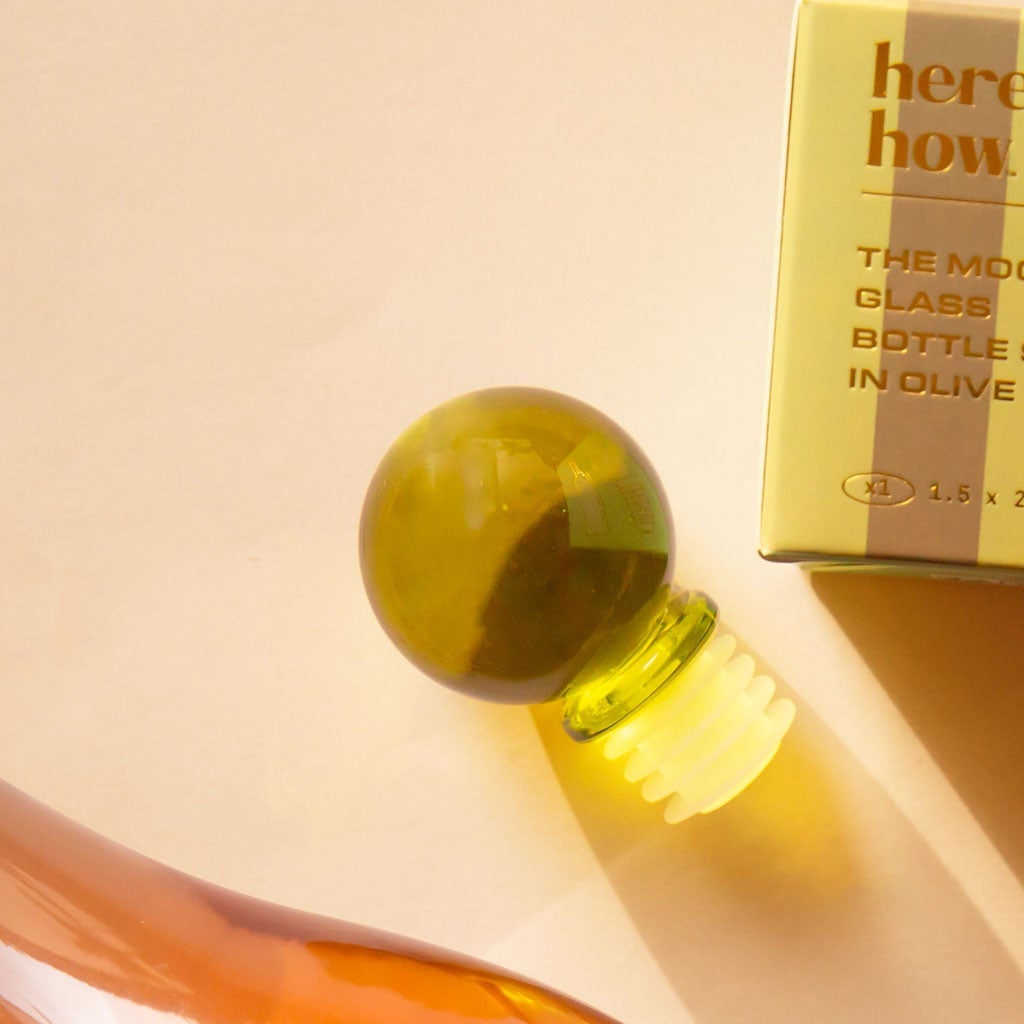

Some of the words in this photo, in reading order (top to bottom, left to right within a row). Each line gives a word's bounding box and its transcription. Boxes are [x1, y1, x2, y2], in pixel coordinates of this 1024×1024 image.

[857, 246, 937, 273] THE
[855, 288, 991, 319] GLASS
[852, 328, 1010, 361] BOTTLE
[848, 368, 888, 391] IN
[900, 371, 1017, 402] OLIVE
[864, 478, 891, 497] x1
[929, 481, 971, 504] 1.5
[985, 490, 998, 506] x
